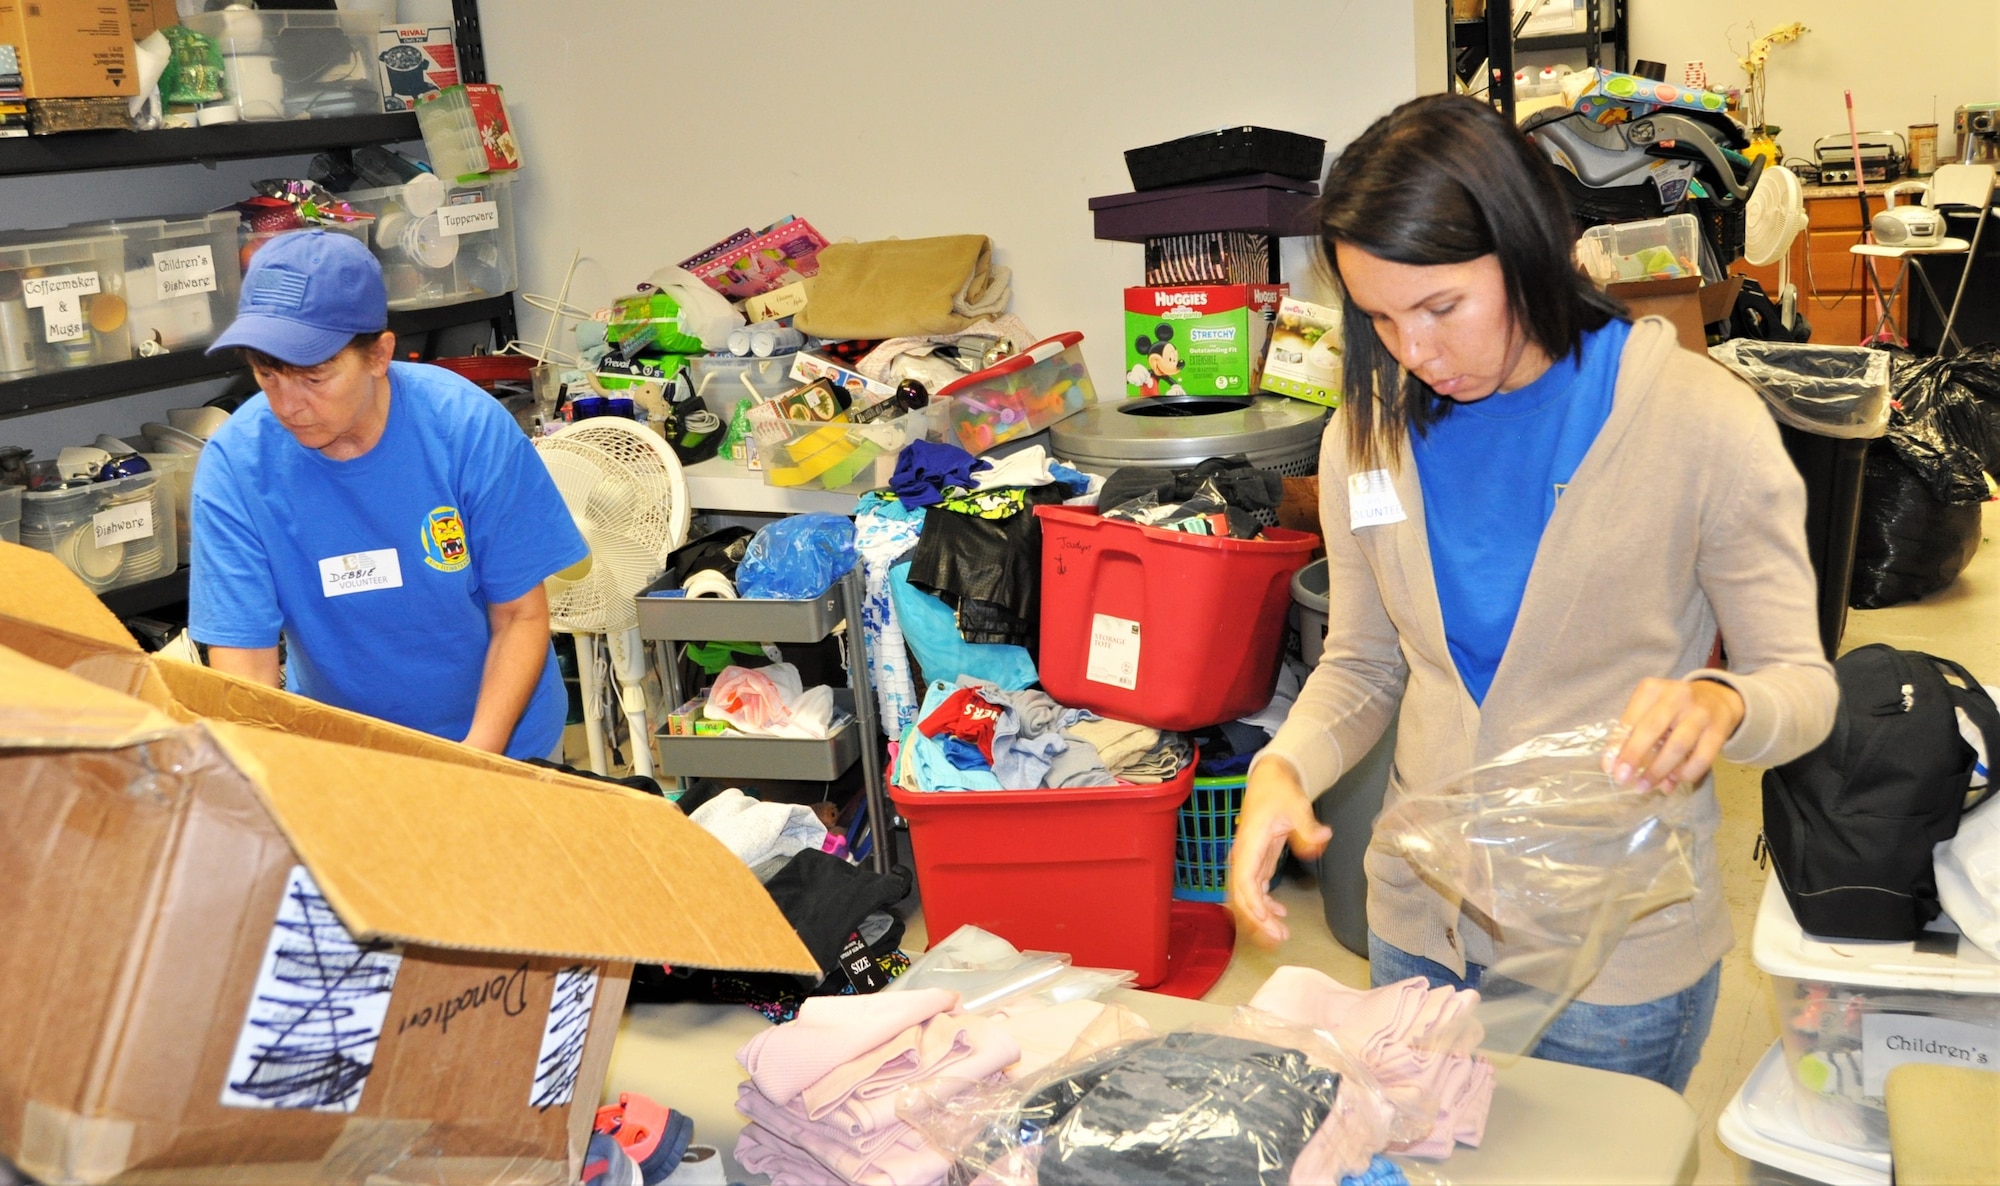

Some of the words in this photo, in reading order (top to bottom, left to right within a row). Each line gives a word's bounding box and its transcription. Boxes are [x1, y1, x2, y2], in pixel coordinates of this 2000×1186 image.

[443, 211, 495, 227] Tupperware
[158, 254, 209, 273] Children's
[24, 276, 96, 295] Coffeemaker
[163, 276, 211, 294] Dishware
[58, 300, 68, 313] &
[1154, 291, 1208, 307] HUGGIES
[49, 323, 81, 337] Mugs
[1191, 328, 1235, 341] STRETCHY
[604, 357, 631, 369] Prevail
[95, 518, 145, 538] Dishware
[329, 567, 376, 583] DEBBIE
[339, 575, 389, 590] VOLUNTEER
[1094, 633, 1126, 646] STORAGE
[1094, 640, 1112, 649] TOTE
[850, 955, 872, 975] SIZE
[866, 974, 875, 987] 4
[1885, 1034, 1989, 1064] Children's
